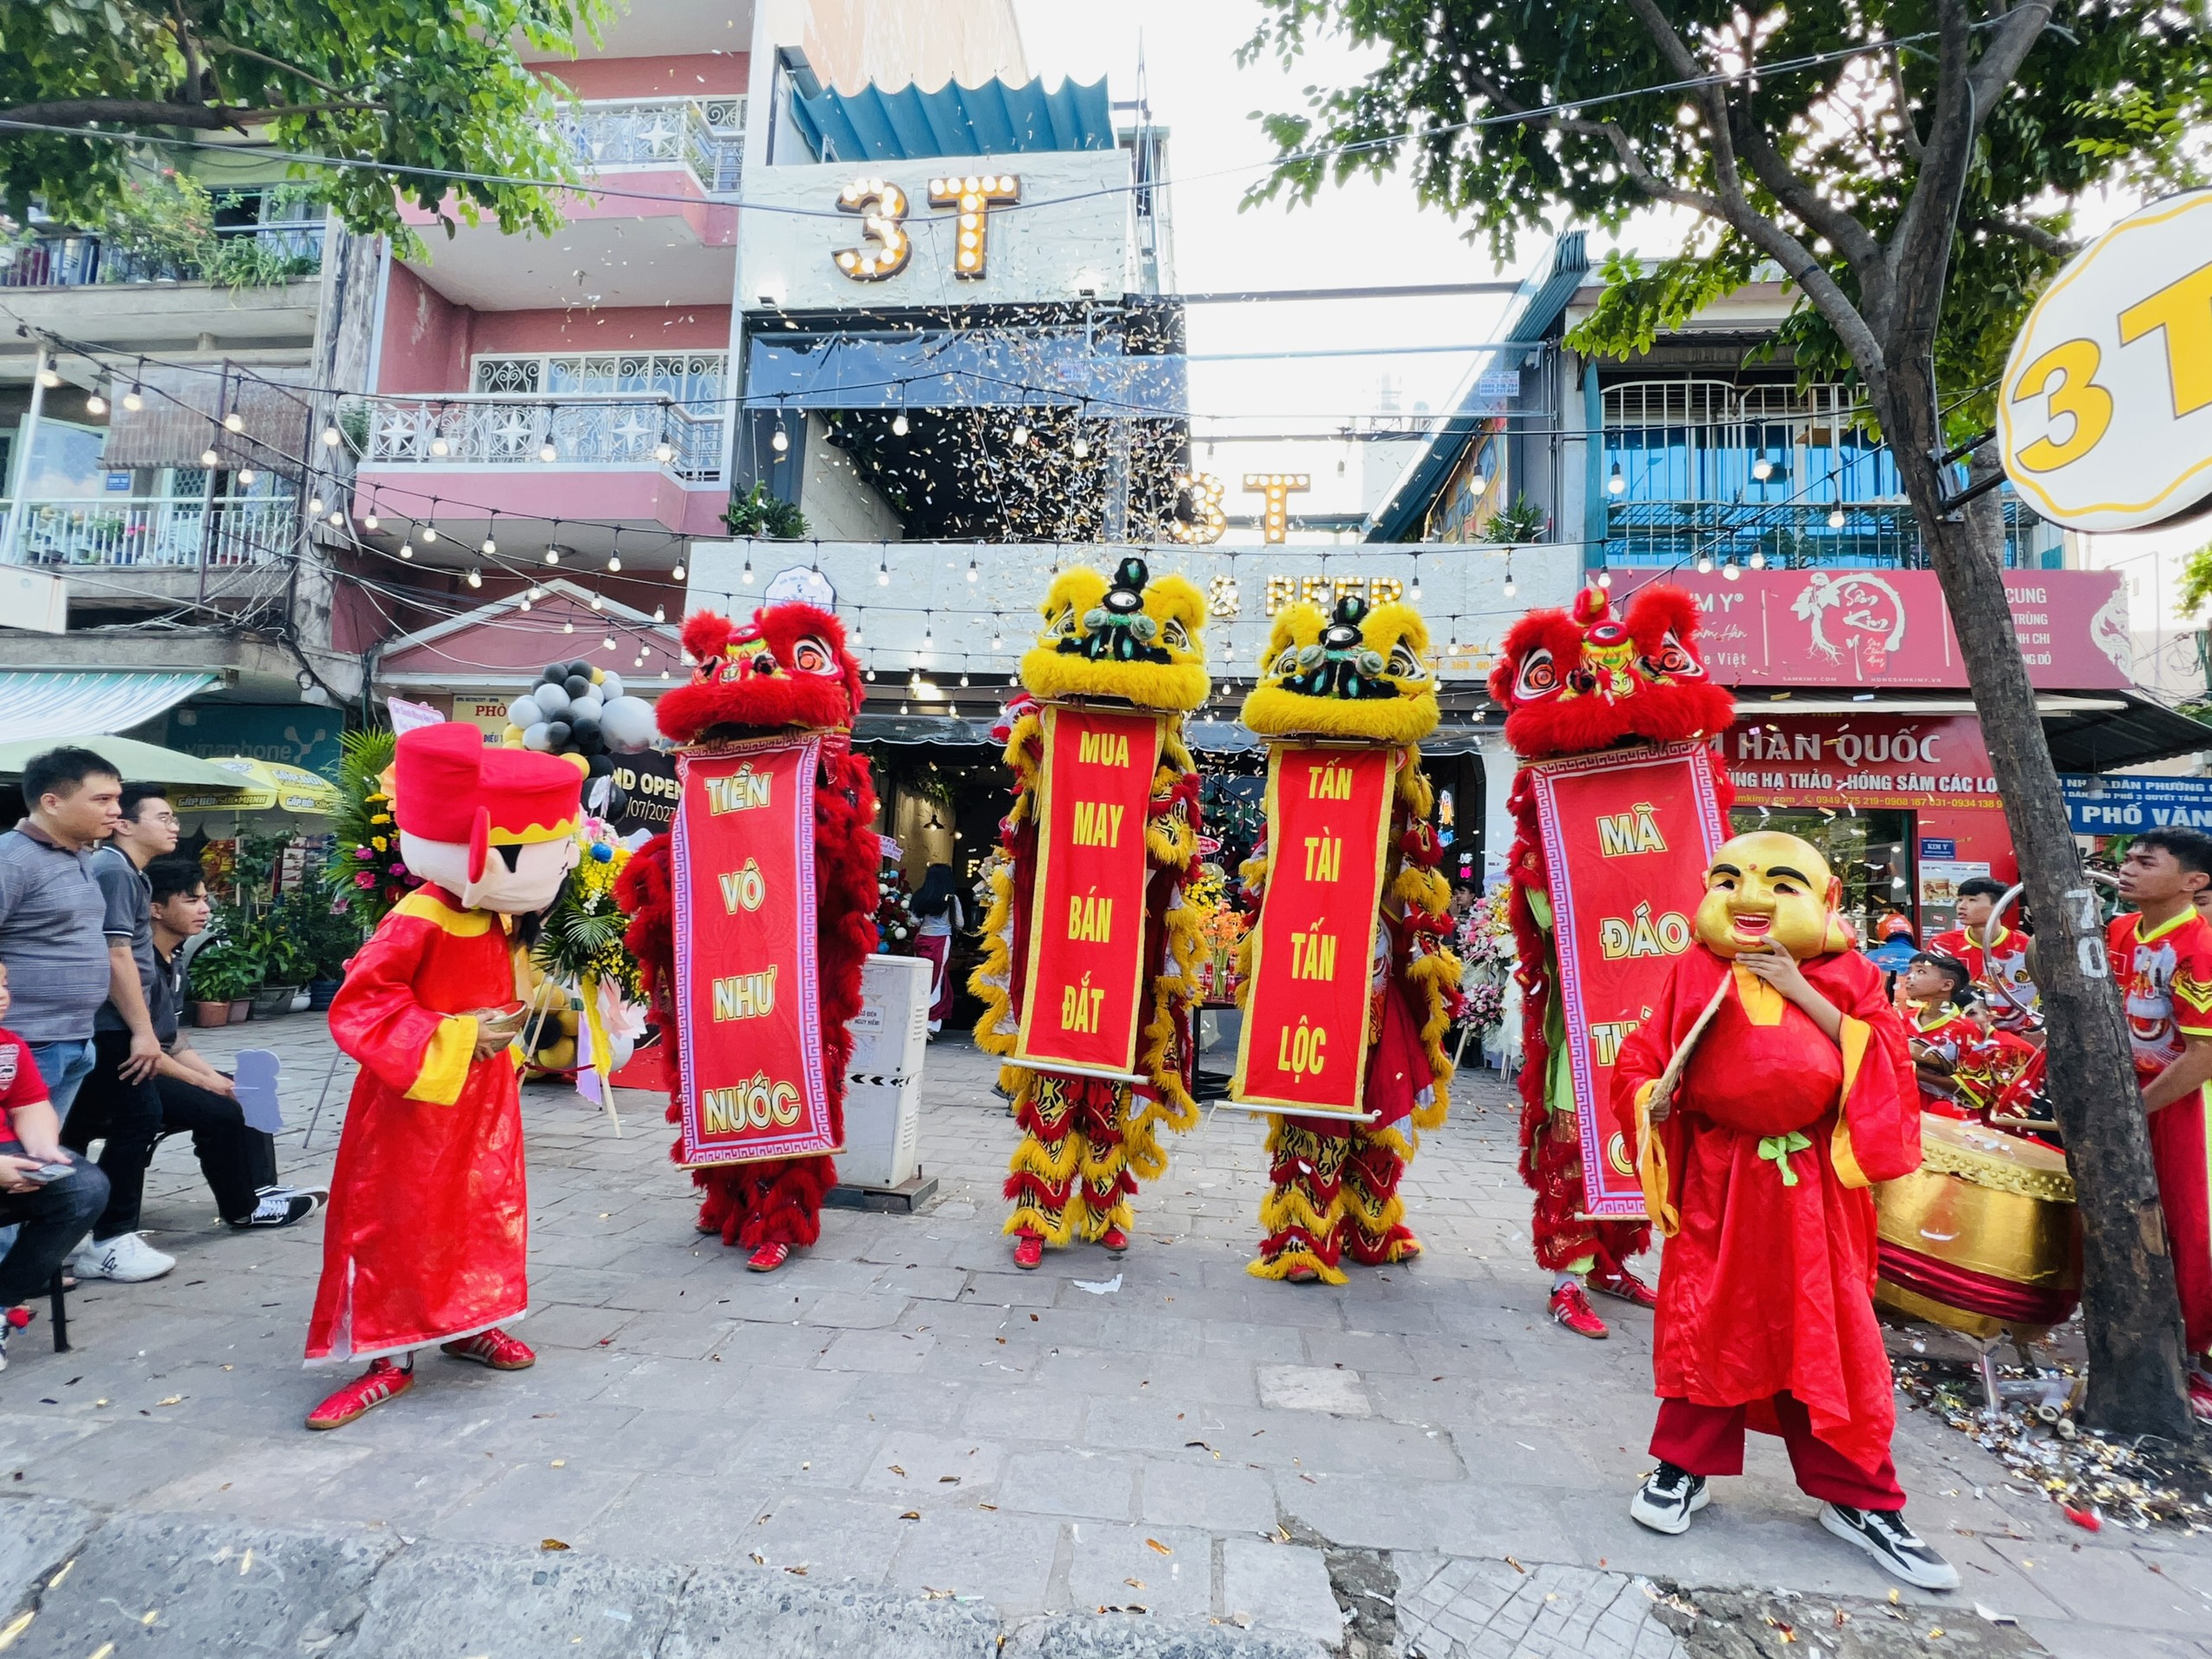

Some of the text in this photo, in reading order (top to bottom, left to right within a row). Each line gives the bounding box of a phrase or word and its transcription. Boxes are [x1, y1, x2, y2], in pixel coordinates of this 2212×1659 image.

[831, 175, 1021, 281] 3T
[2012, 259, 2212, 475] 3T
[2004, 587, 2048, 604] CUNG
[1717, 652, 1747, 668] Việt
[2032, 632, 2051, 645] CHI
[1078, 730, 1129, 768] MUA
[1738, 728, 1821, 761] HÀN
[1836, 724, 1942, 767] QUỐC
[704, 761, 774, 817] TIỀN
[1307, 756, 1354, 801] TẤN
[1789, 769, 1833, 790] THẢO
[1847, 769, 1891, 791] HỒNG
[1897, 772, 1936, 792] SÂM
[1939, 773, 1973, 793] CÁC
[1072, 800, 1125, 849] MAY
[1596, 801, 1669, 858] MÃ
[2082, 802, 2143, 825] PHỐ
[2151, 805, 2212, 828] VĂN
[1304, 825, 1342, 883] TÀI
[718, 856, 766, 916] VÔ
[1068, 885, 1114, 944] BÁN
[1290, 916, 1338, 982] TẤN
[1600, 899, 1691, 960] ĐÁO
[711, 963, 778, 1023] NHƯ
[1060, 969, 1105, 1034] ĐẮT
[1277, 1014, 1327, 1084] LỘC
[702, 1068, 802, 1135] NƯỚC
